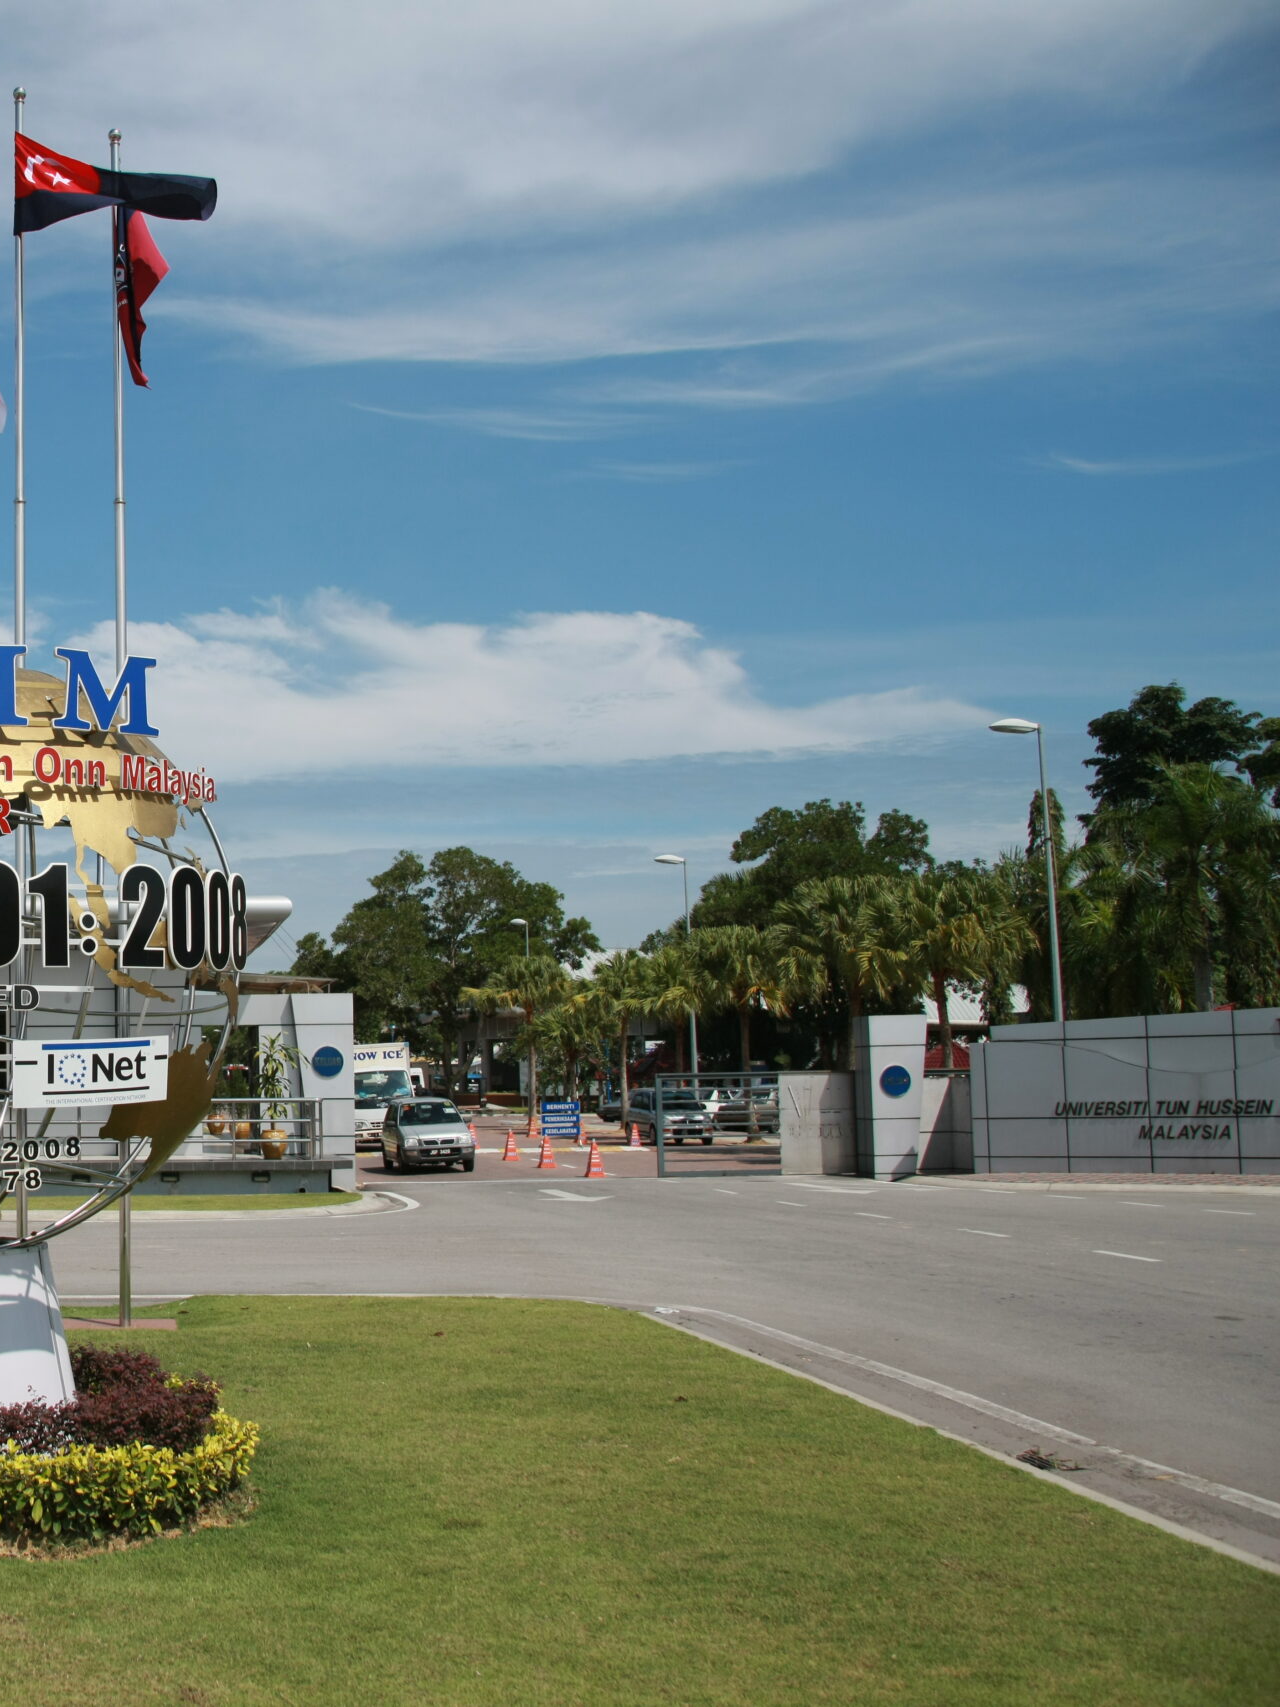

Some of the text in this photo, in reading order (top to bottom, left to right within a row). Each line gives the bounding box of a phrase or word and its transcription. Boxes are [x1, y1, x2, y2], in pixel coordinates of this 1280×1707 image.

[34, 746, 107, 787] Onn
[121, 753, 217, 805] Malaysia
[383, 1050, 404, 1060] ICE
[1054, 1098, 1273, 1116] UNIVERSITI TUN HUSSEIN
[1138, 1125, 1231, 1140] MALAYSIA
